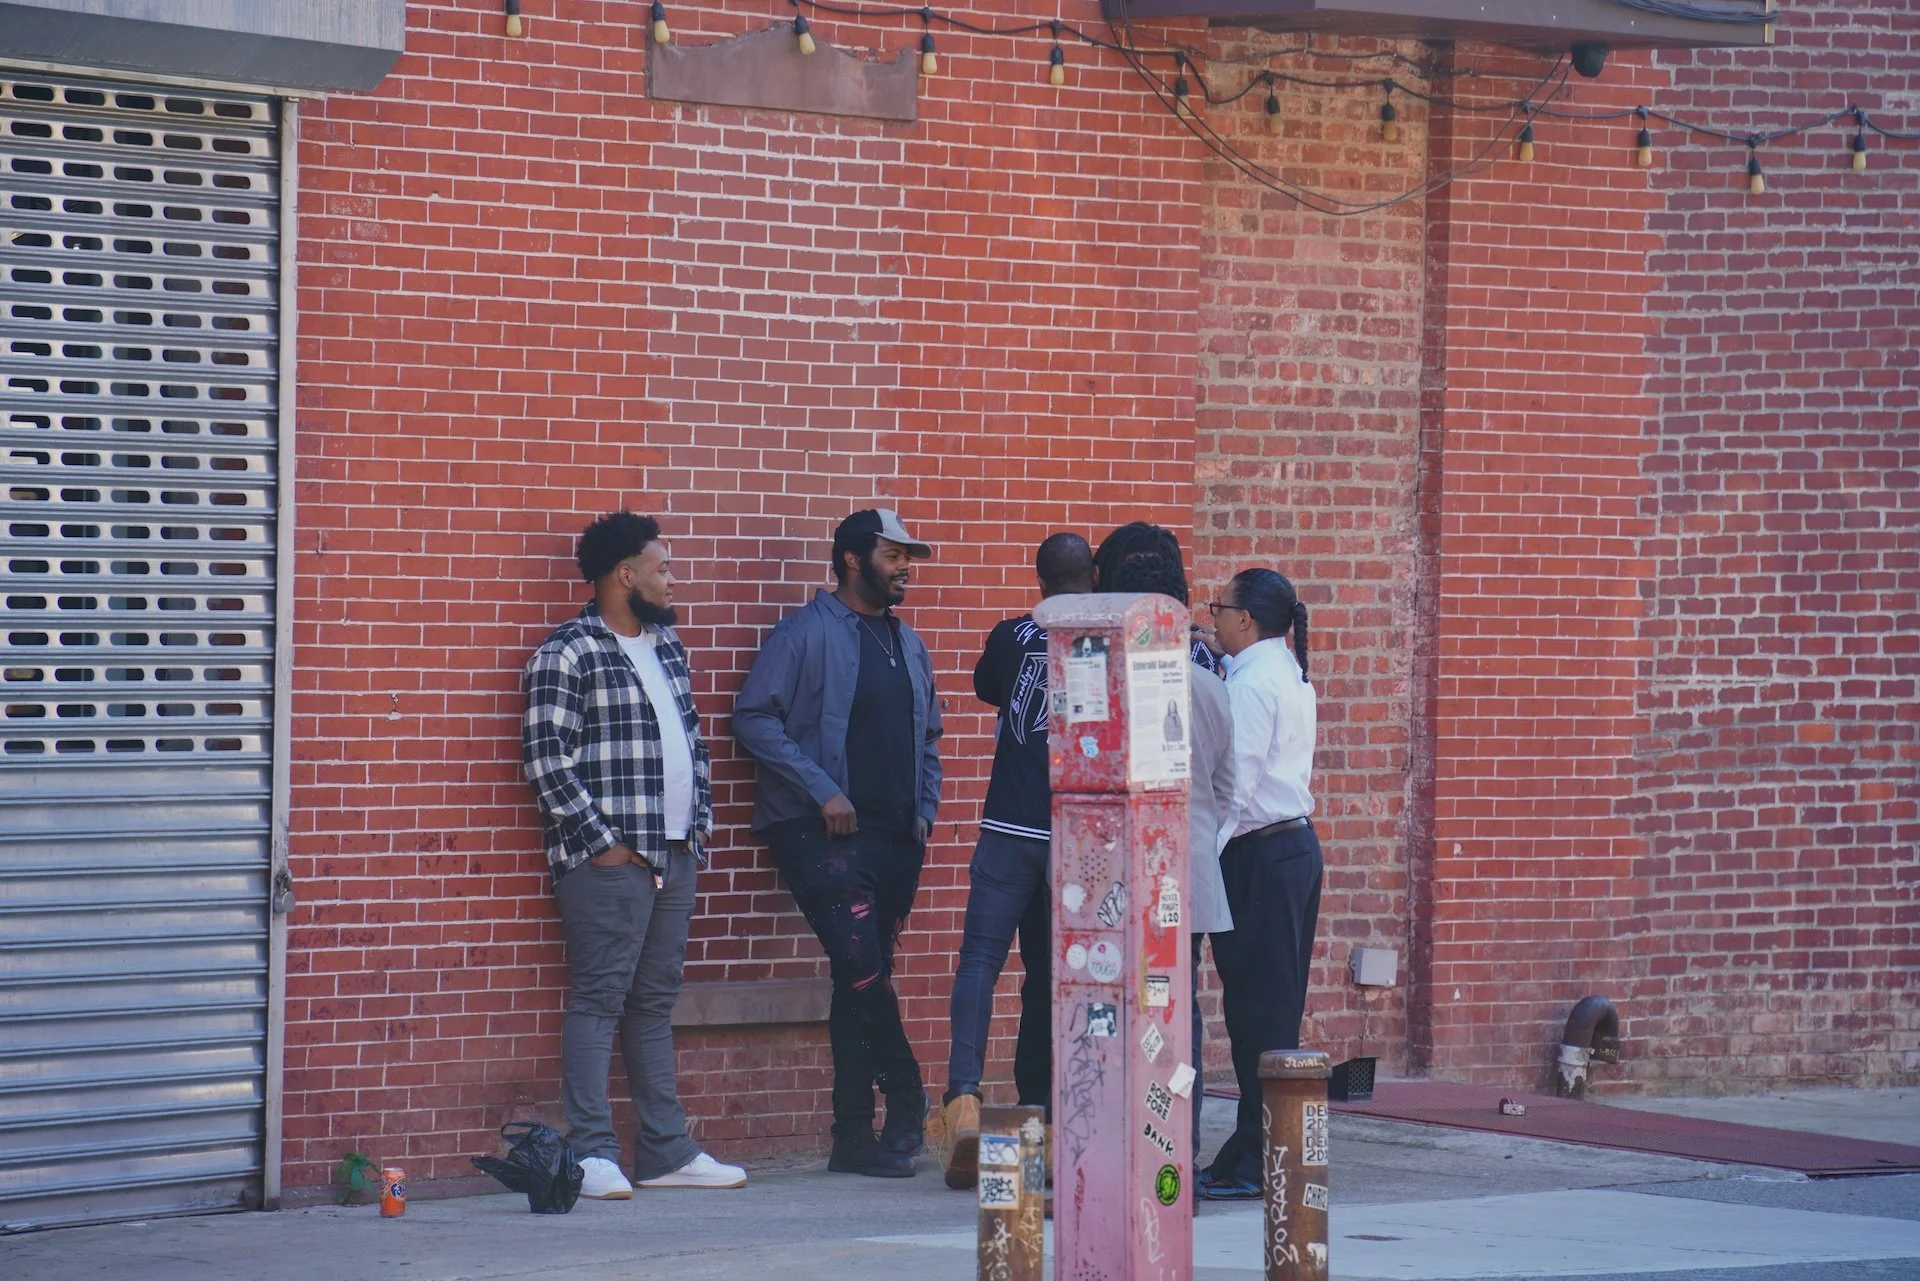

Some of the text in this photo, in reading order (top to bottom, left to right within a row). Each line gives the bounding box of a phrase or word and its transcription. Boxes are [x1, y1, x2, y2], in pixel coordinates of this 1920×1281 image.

[1011, 664, 1034, 715] Brooklyn
[1306, 1104, 1328, 1117] DE
[1306, 1118, 1328, 1130] 2D
[1306, 1136, 1328, 1148] DE
[1306, 1150, 1328, 1162] 2D
